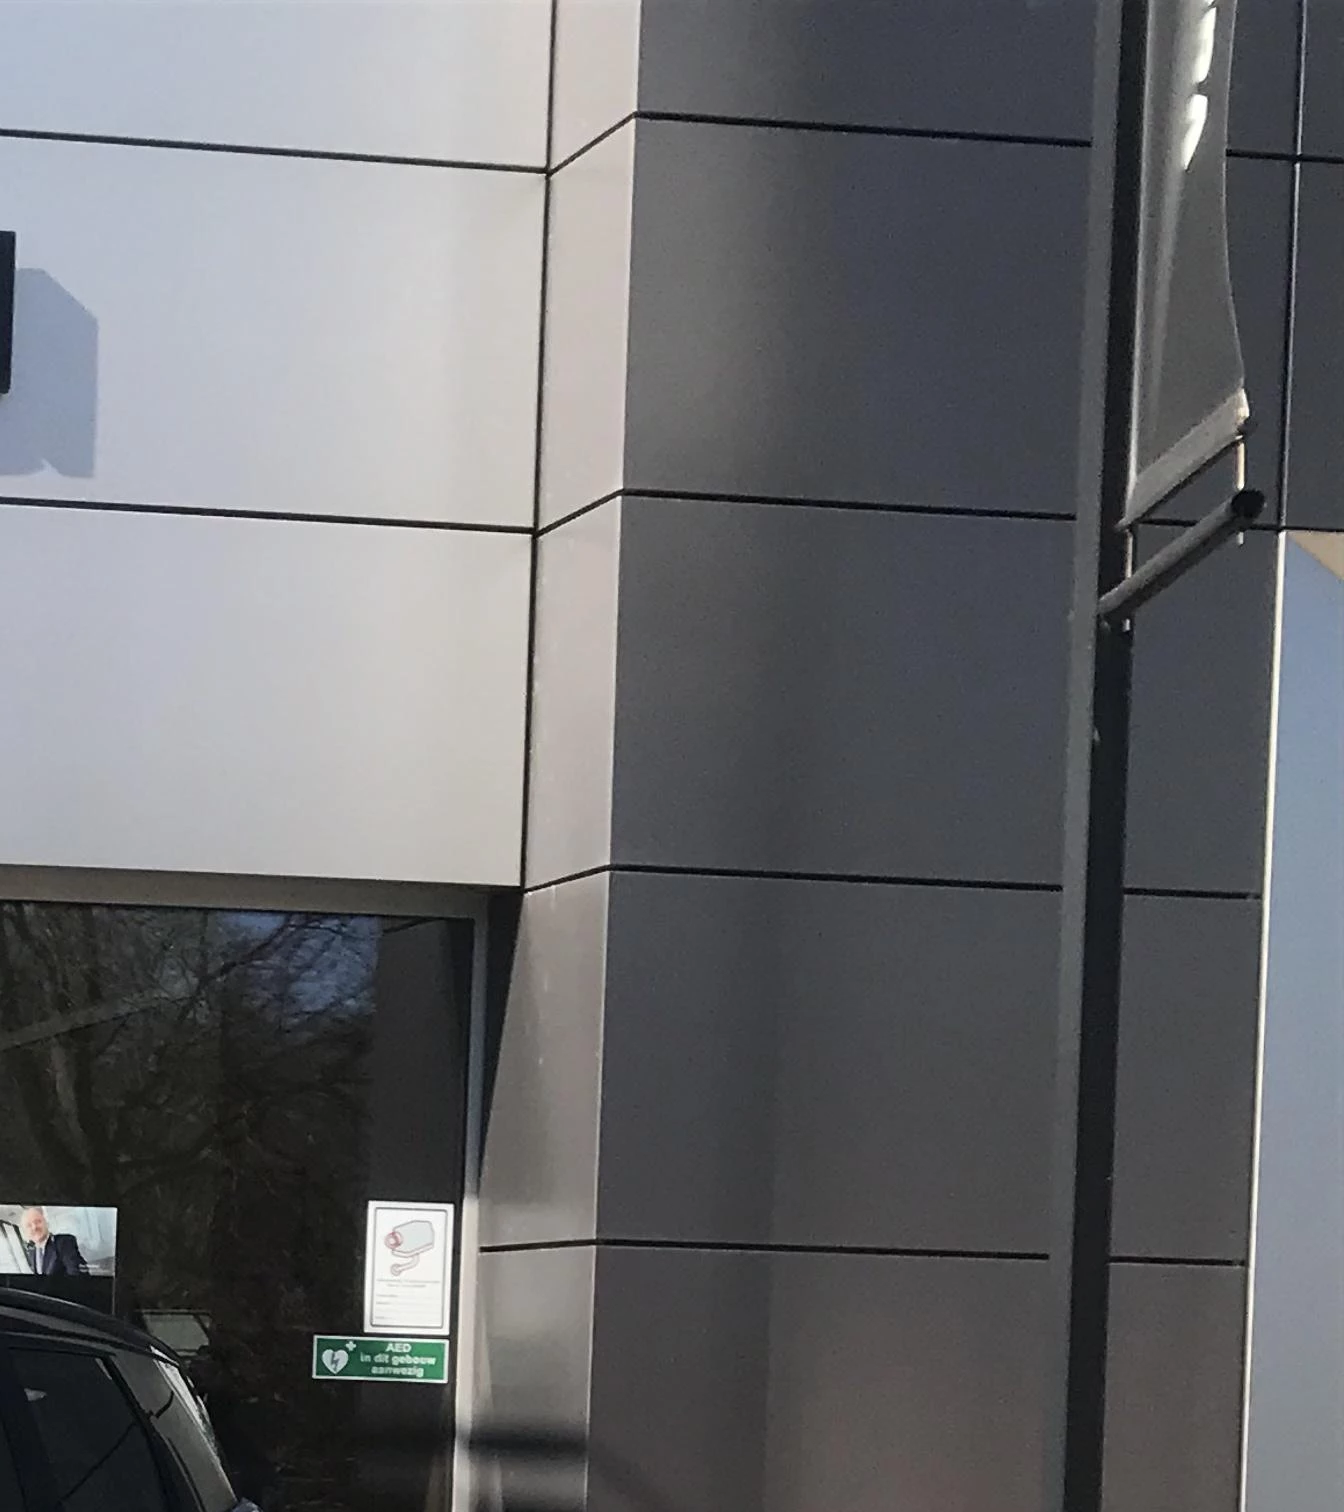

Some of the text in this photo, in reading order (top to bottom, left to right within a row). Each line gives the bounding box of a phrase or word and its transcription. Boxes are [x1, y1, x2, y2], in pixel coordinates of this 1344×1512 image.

[385, 1342, 412, 1353] AED
[373, 1353, 390, 1364] dit
[391, 1354, 437, 1366] gebouw
[371, 1366, 425, 1378] aanwezig
